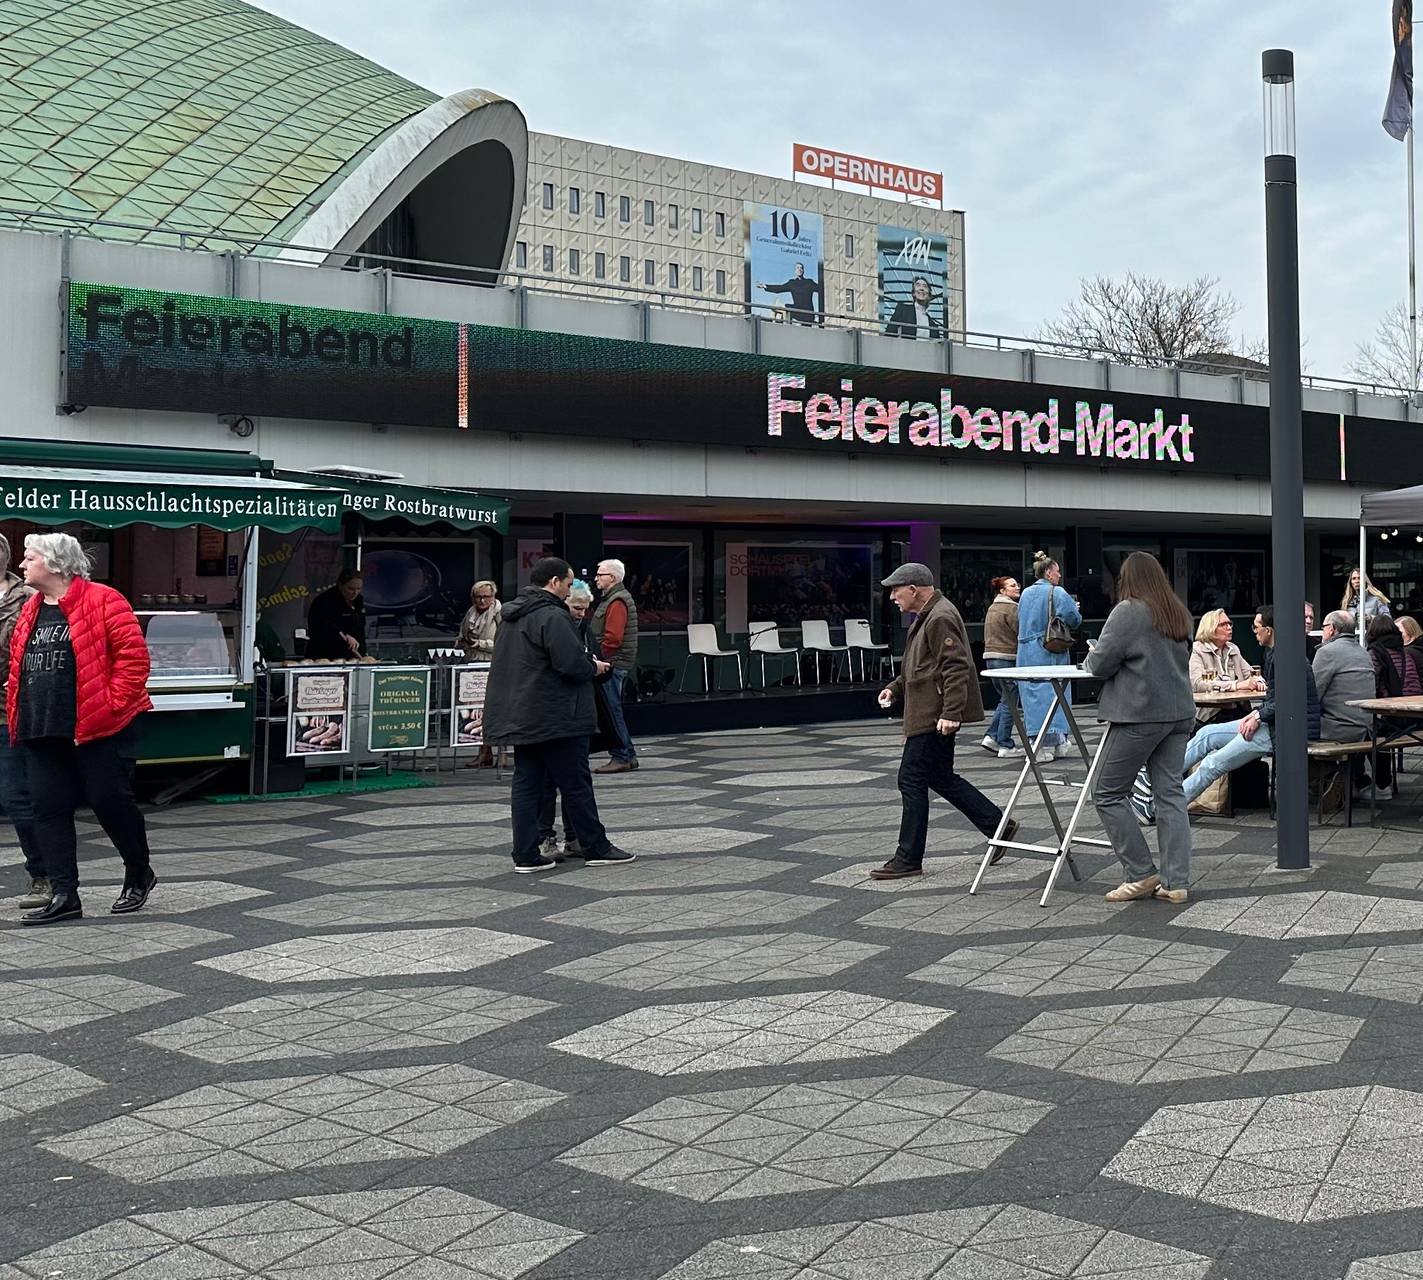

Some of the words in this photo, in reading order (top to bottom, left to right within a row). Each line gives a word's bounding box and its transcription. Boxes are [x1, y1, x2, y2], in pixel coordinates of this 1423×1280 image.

[802, 150, 936, 195] OPERNHAUS
[770, 209, 800, 241] 10
[78, 292, 414, 370] Feierabend
[767, 372, 1195, 463] Feierabend-Markt
[68, 489, 337, 518] Hausschlachtspezialitäten
[384, 494, 498, 524] Rostbratwurst
[400, 722, 416, 730] 3,50
